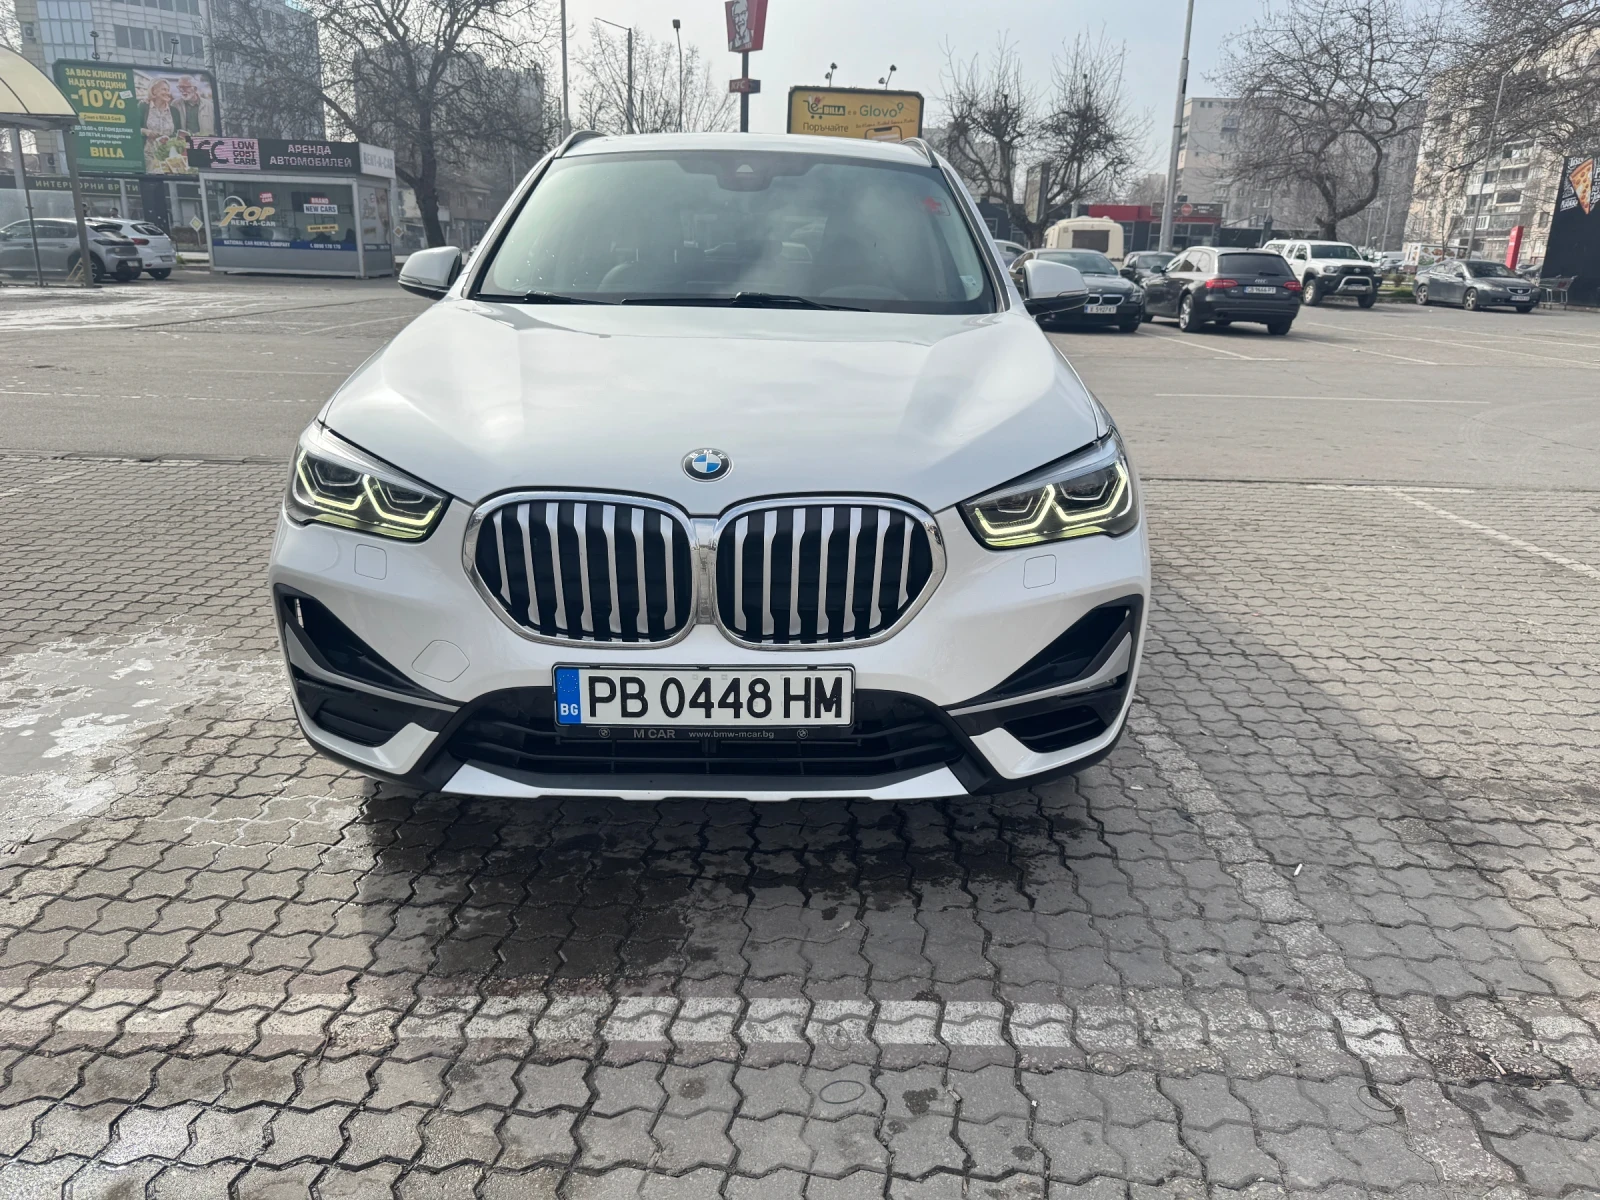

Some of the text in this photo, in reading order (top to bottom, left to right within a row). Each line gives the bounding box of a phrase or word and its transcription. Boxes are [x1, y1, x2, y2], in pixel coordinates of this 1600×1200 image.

[65, 67, 127, 80] ЗА ВАС КЛИЕНТИ
[68, 78, 127, 90] НАД 65 ГОДИНИ
[730, 81, 746, 90] KFC
[70, 88, 126, 109] -10%
[860, 104, 898, 118] Glovo
[802, 121, 849, 133] Поръчайте
[89, 146, 125, 159] BILLA
[287, 144, 332, 156] АРЕНДА
[269, 155, 352, 168] АВТОМОБИЛЕЙ
[107, 184, 139, 192] ВРТИ
[305, 205, 337, 213] NEW CARS
[218, 205, 276, 228] TOP
[230, 219, 276, 227] RENT-A-CAR
[270, 240, 291, 248] COMPANY
[588, 675, 843, 719] PB 0448 HM
[560, 703, 579, 716] BG
[633, 728, 775, 739] M CAR www.bmw-mcar.bg
